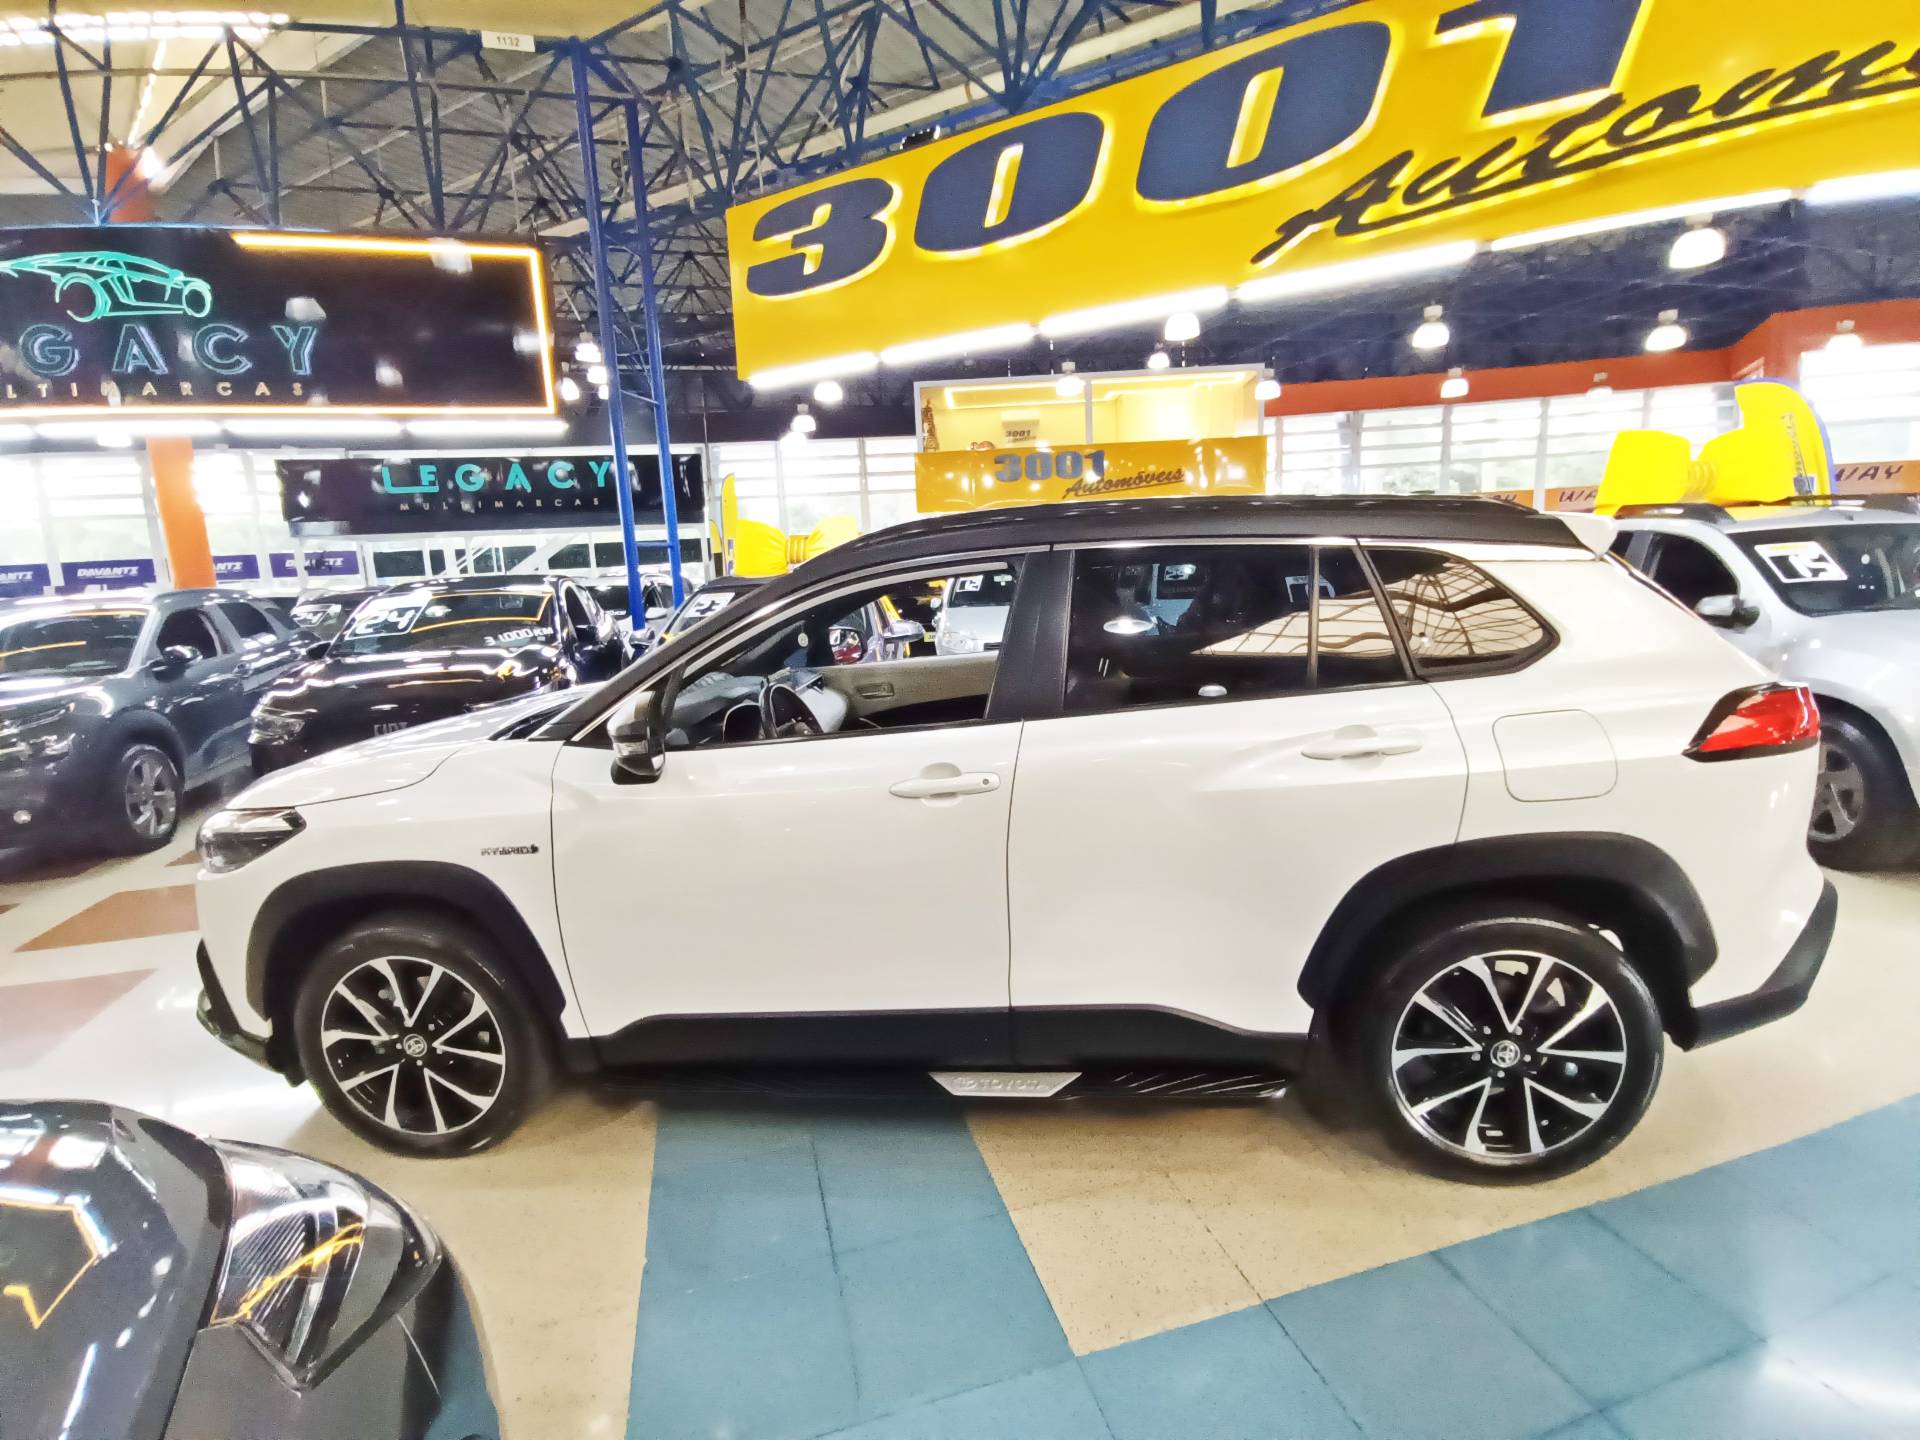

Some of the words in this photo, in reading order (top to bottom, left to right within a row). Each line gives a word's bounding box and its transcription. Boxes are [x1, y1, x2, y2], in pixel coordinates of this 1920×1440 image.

[746, 0, 1648, 298] 3001
[1251, 41, 1920, 266] Autom
[18, 323, 317, 375] GACY
[382, 460, 611, 494] LEGACY
[993, 450, 1105, 482] 3001
[1062, 468, 1185, 499] Automóveis
[400, 497, 600, 514] MULTIMARCAS
[356, 608, 416, 635] 24
